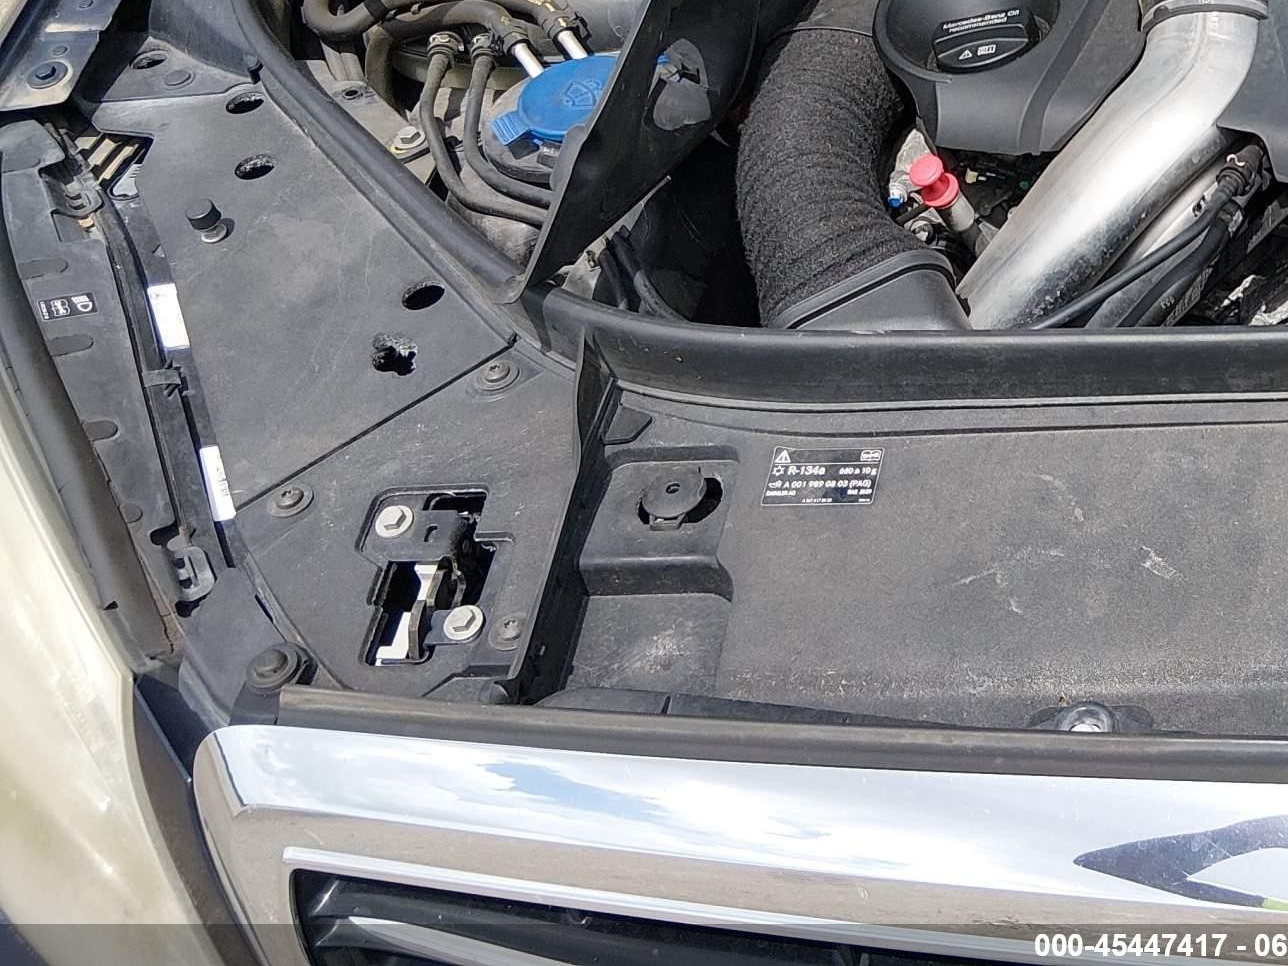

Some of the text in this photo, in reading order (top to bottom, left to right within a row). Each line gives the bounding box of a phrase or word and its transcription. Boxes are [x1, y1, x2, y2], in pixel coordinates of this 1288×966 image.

[943, 9, 1020, 30] Mercedes-Benz Oil
[948, 17, 1008, 33] recommended
[787, 465, 826, 476] R-134a
